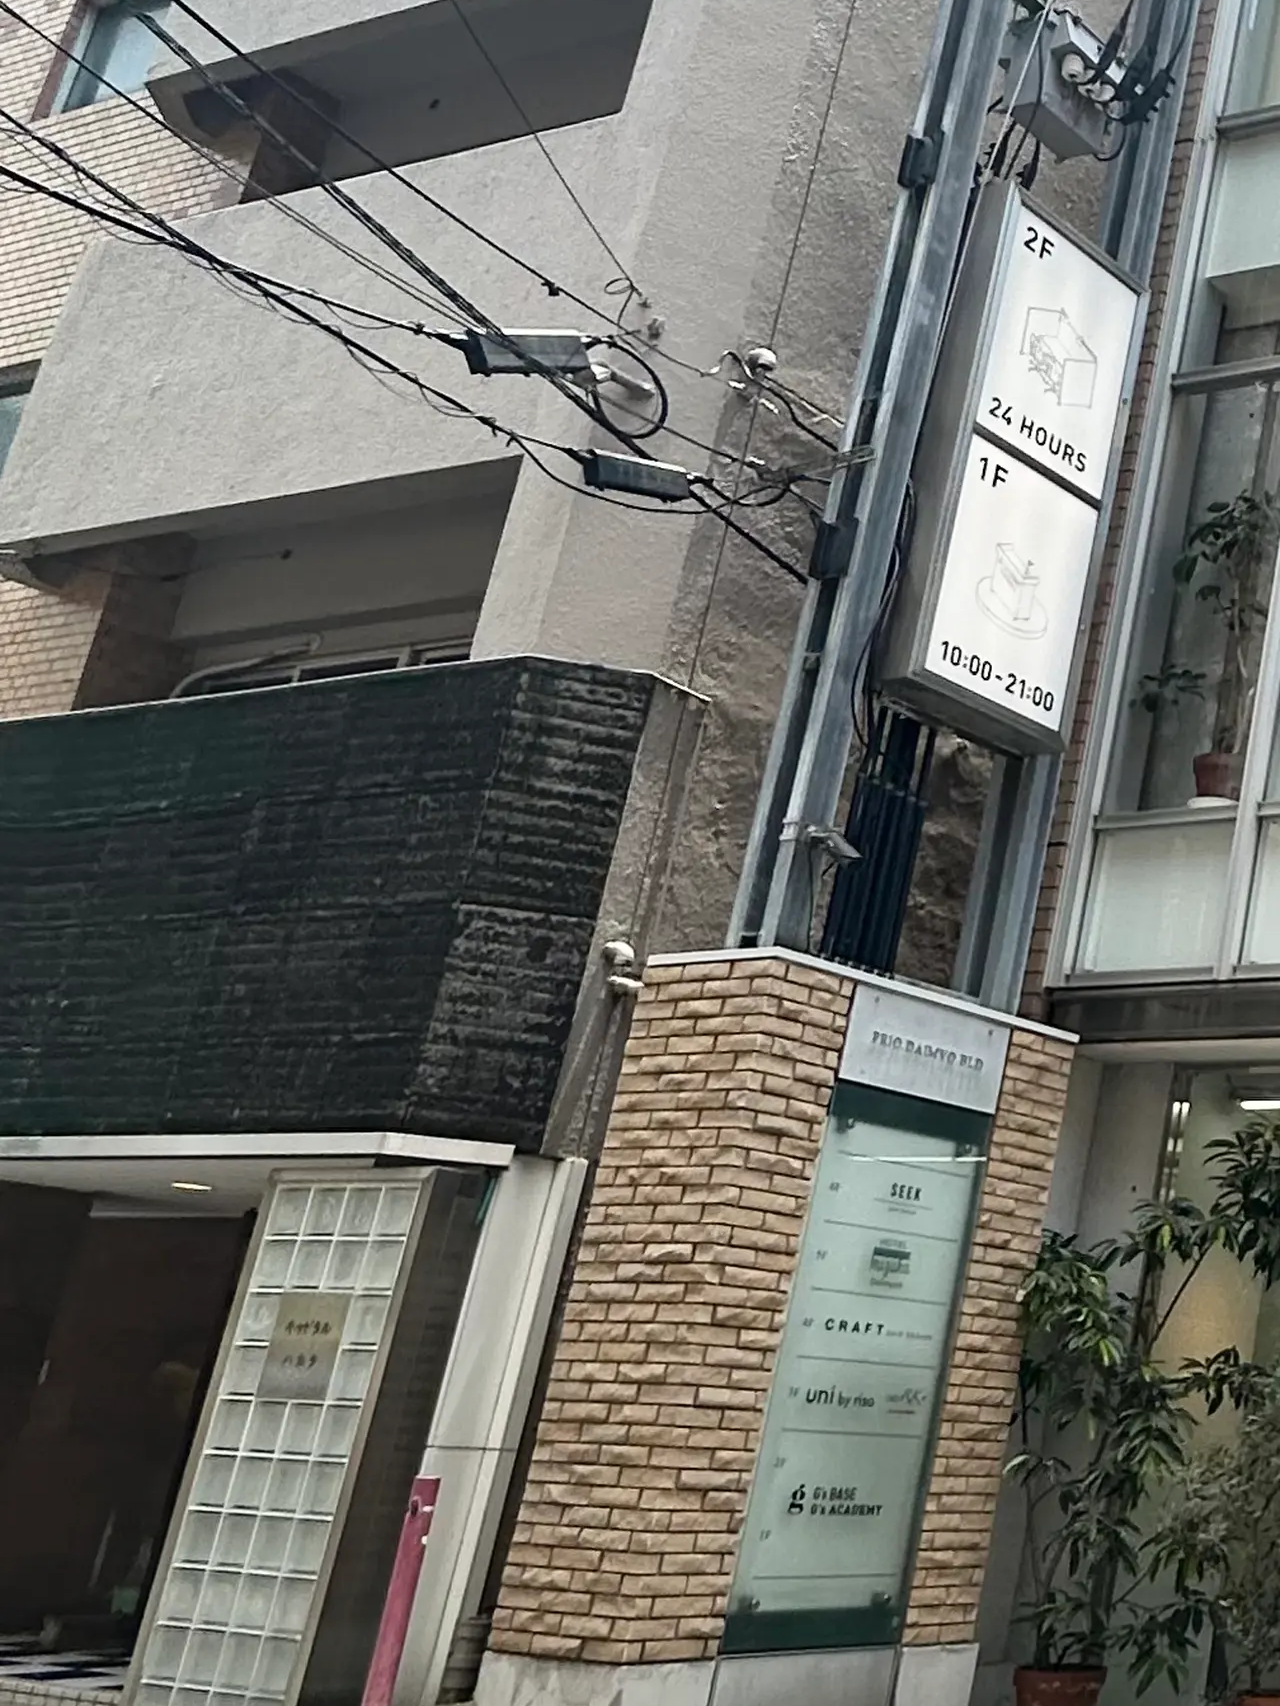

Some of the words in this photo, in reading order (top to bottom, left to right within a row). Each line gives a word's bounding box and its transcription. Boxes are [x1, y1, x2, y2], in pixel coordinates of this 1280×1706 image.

[1023, 226, 1055, 261] 2F
[988, 397, 1014, 427] 24
[1019, 416, 1088, 474] HOURS
[977, 457, 1009, 490] 1F
[939, 640, 1055, 713] 10:00-21:00
[959, 1053, 984, 1072] BLD
[890, 1181, 922, 1202] SEEK
[824, 1317, 885, 1336] CRAFT
[805, 1384, 837, 1406] uni
[837, 1391, 852, 1409] by
[829, 1487, 857, 1502] BASE
[828, 1504, 884, 1516] ACADEMY
